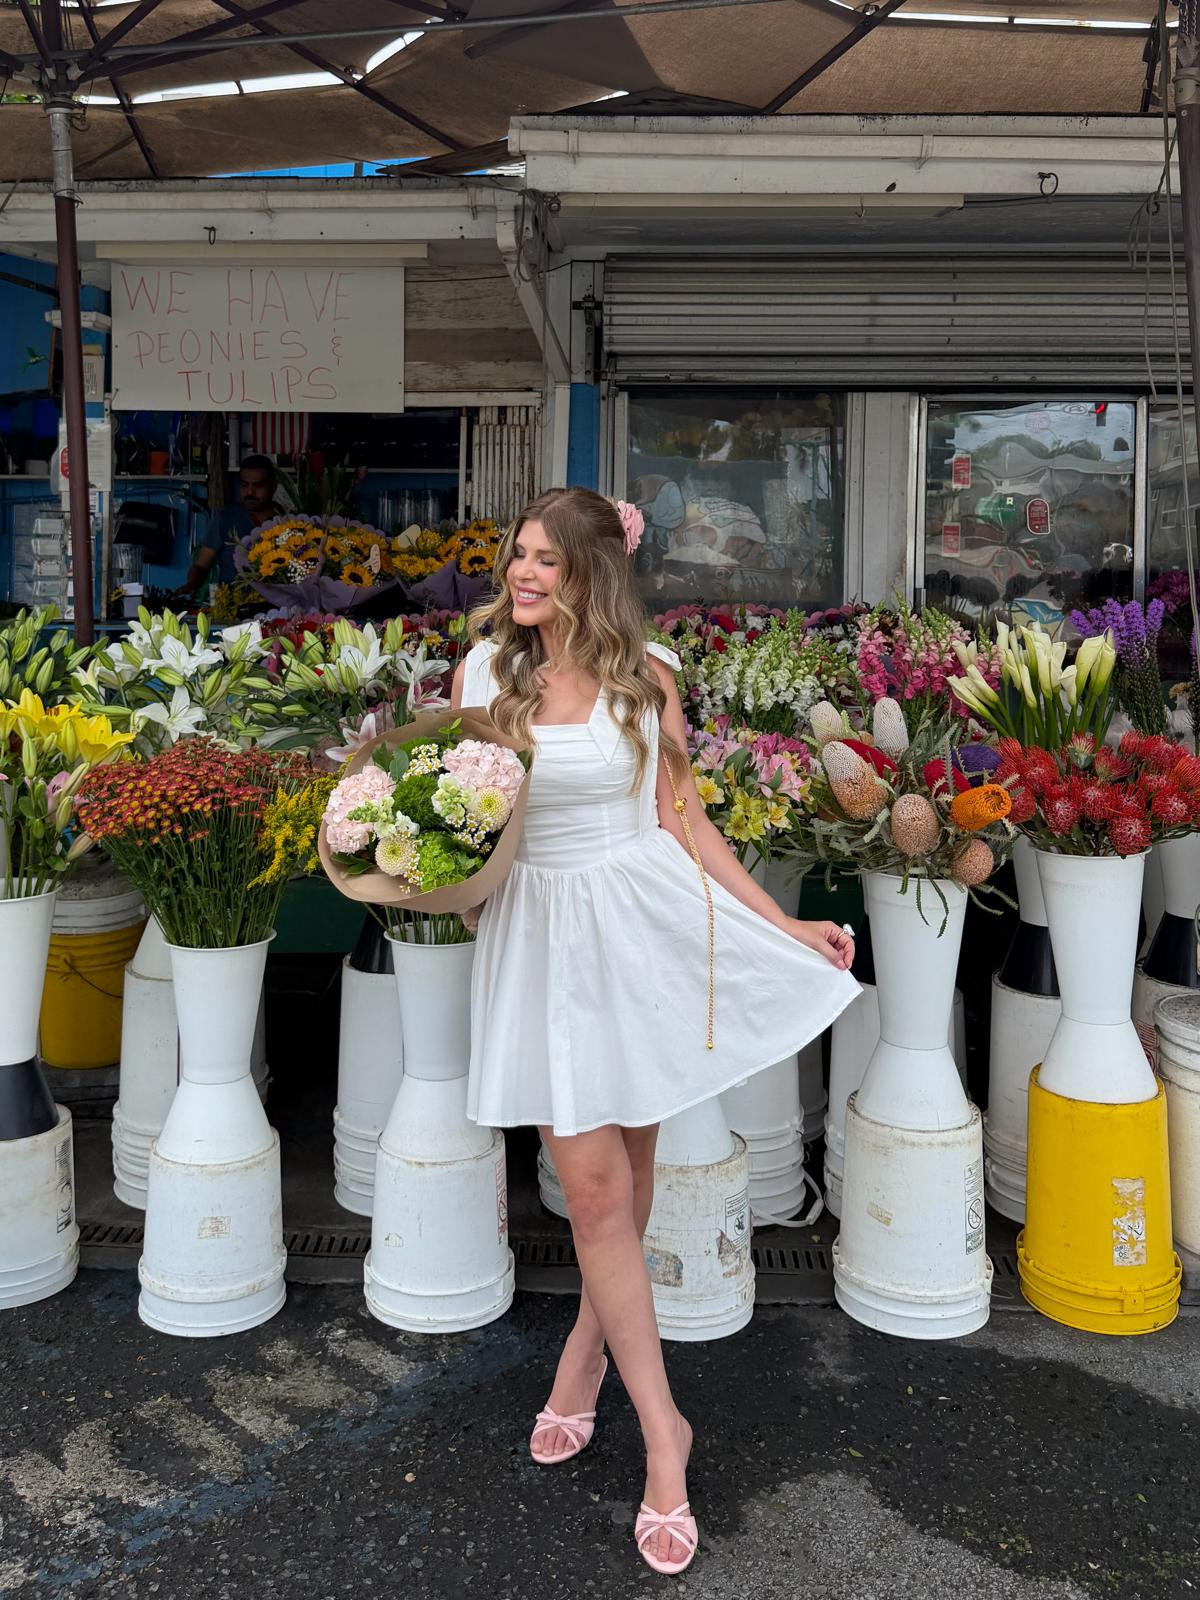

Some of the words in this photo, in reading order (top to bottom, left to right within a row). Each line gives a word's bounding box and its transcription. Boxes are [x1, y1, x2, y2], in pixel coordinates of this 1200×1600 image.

[120, 270, 193, 315] WE
[226, 269, 355, 326] HAVE
[127, 328, 309, 369] PEONIES
[331, 327, 343, 366] &
[176, 365, 338, 405] TULIPS
